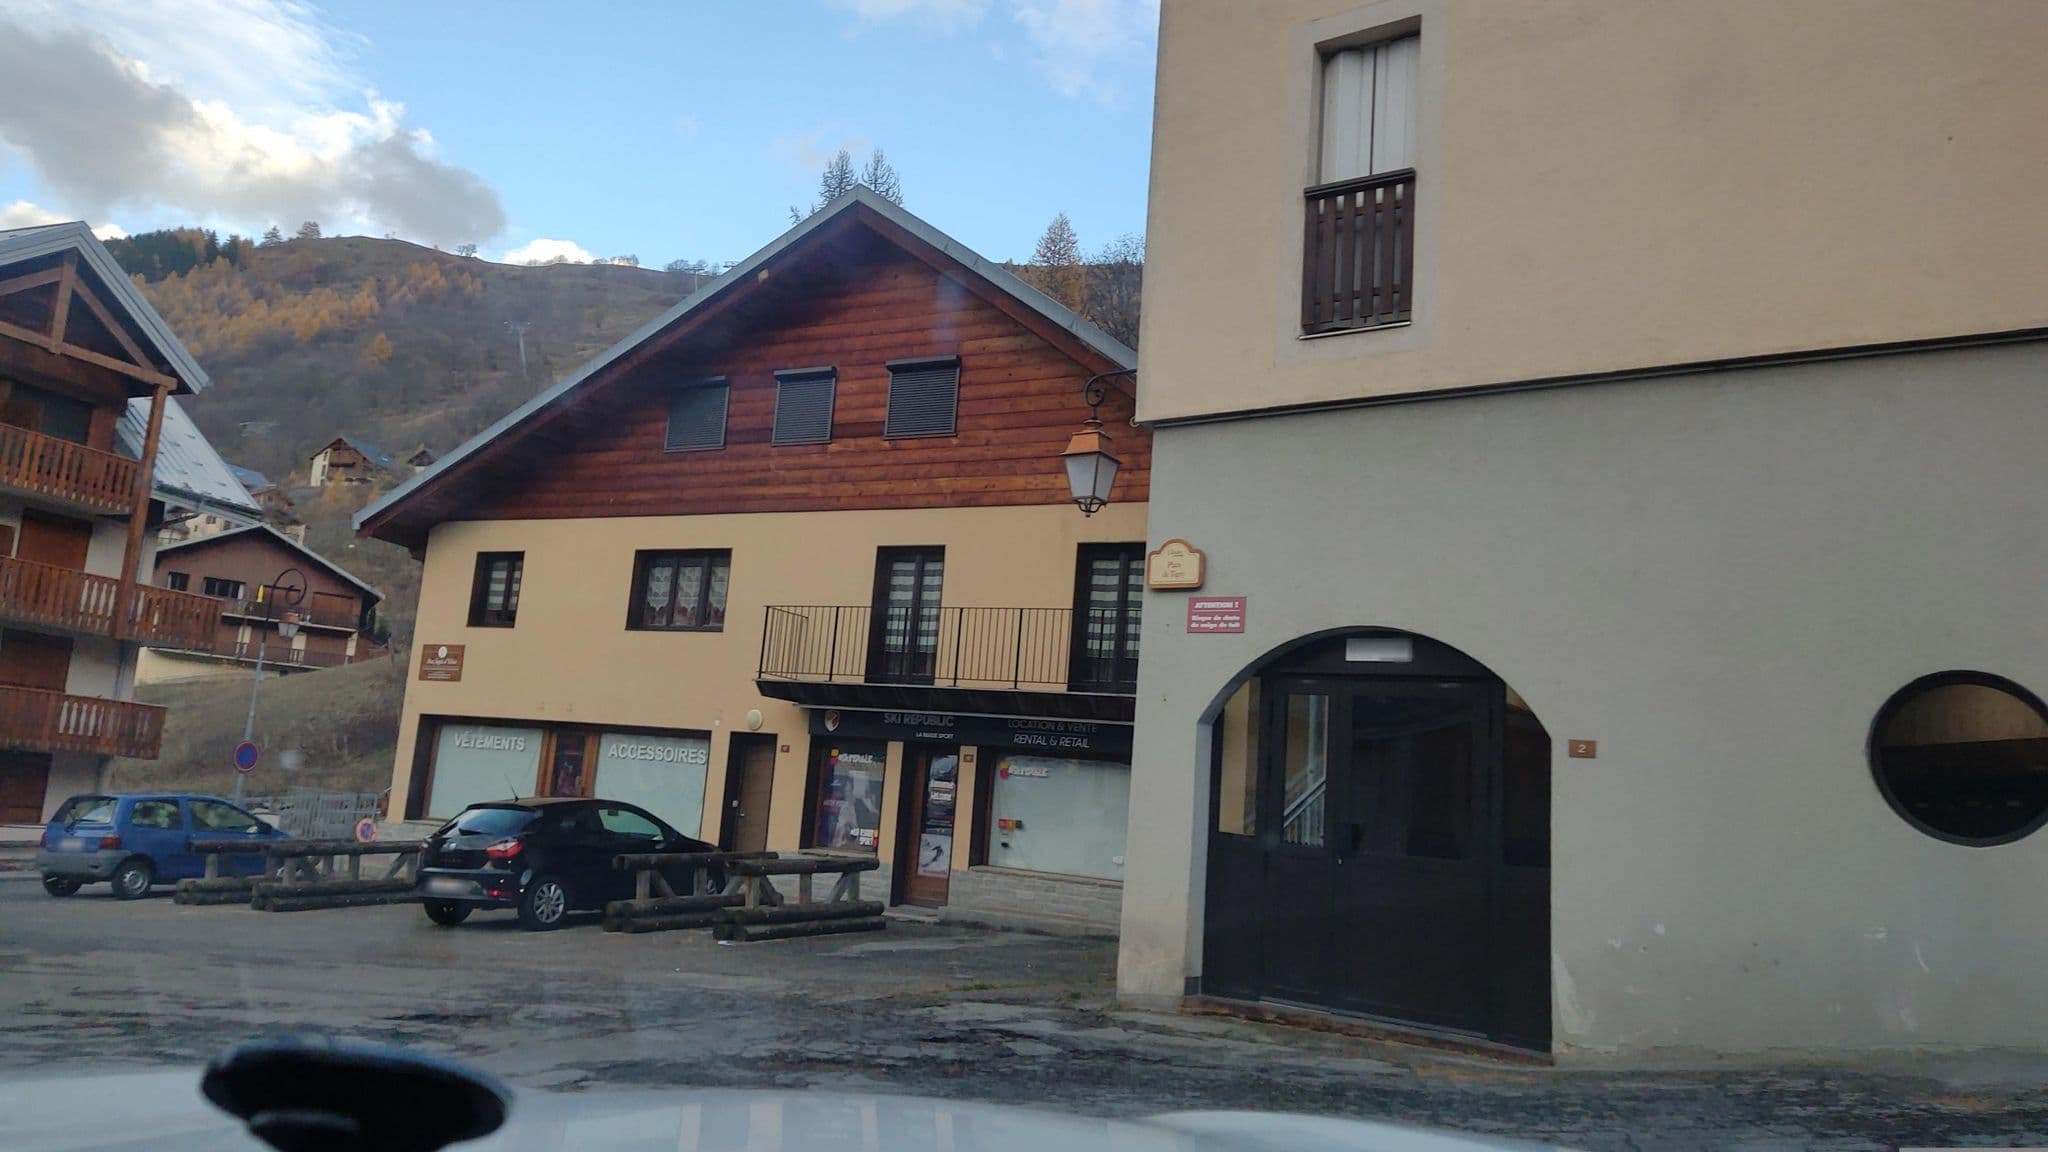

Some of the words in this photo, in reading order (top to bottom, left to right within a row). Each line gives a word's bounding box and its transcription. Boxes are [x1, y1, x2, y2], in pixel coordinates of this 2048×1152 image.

[884, 713, 902, 724] SKI
[903, 714, 955, 727] REPUBLIC
[1007, 719, 1055, 730] LOCATION
[1056, 722, 1064, 731] &
[1067, 723, 1097, 733] VENTE
[453, 731, 526, 751] VÊTEMENTS
[1013, 734, 1048, 745] RENTAL
[1049, 736, 1058, 746] &
[1059, 737, 1090, 748] RETAIL
[607, 743, 708, 765] ACCESSOIRES
[1577, 744, 1586, 753] 2
